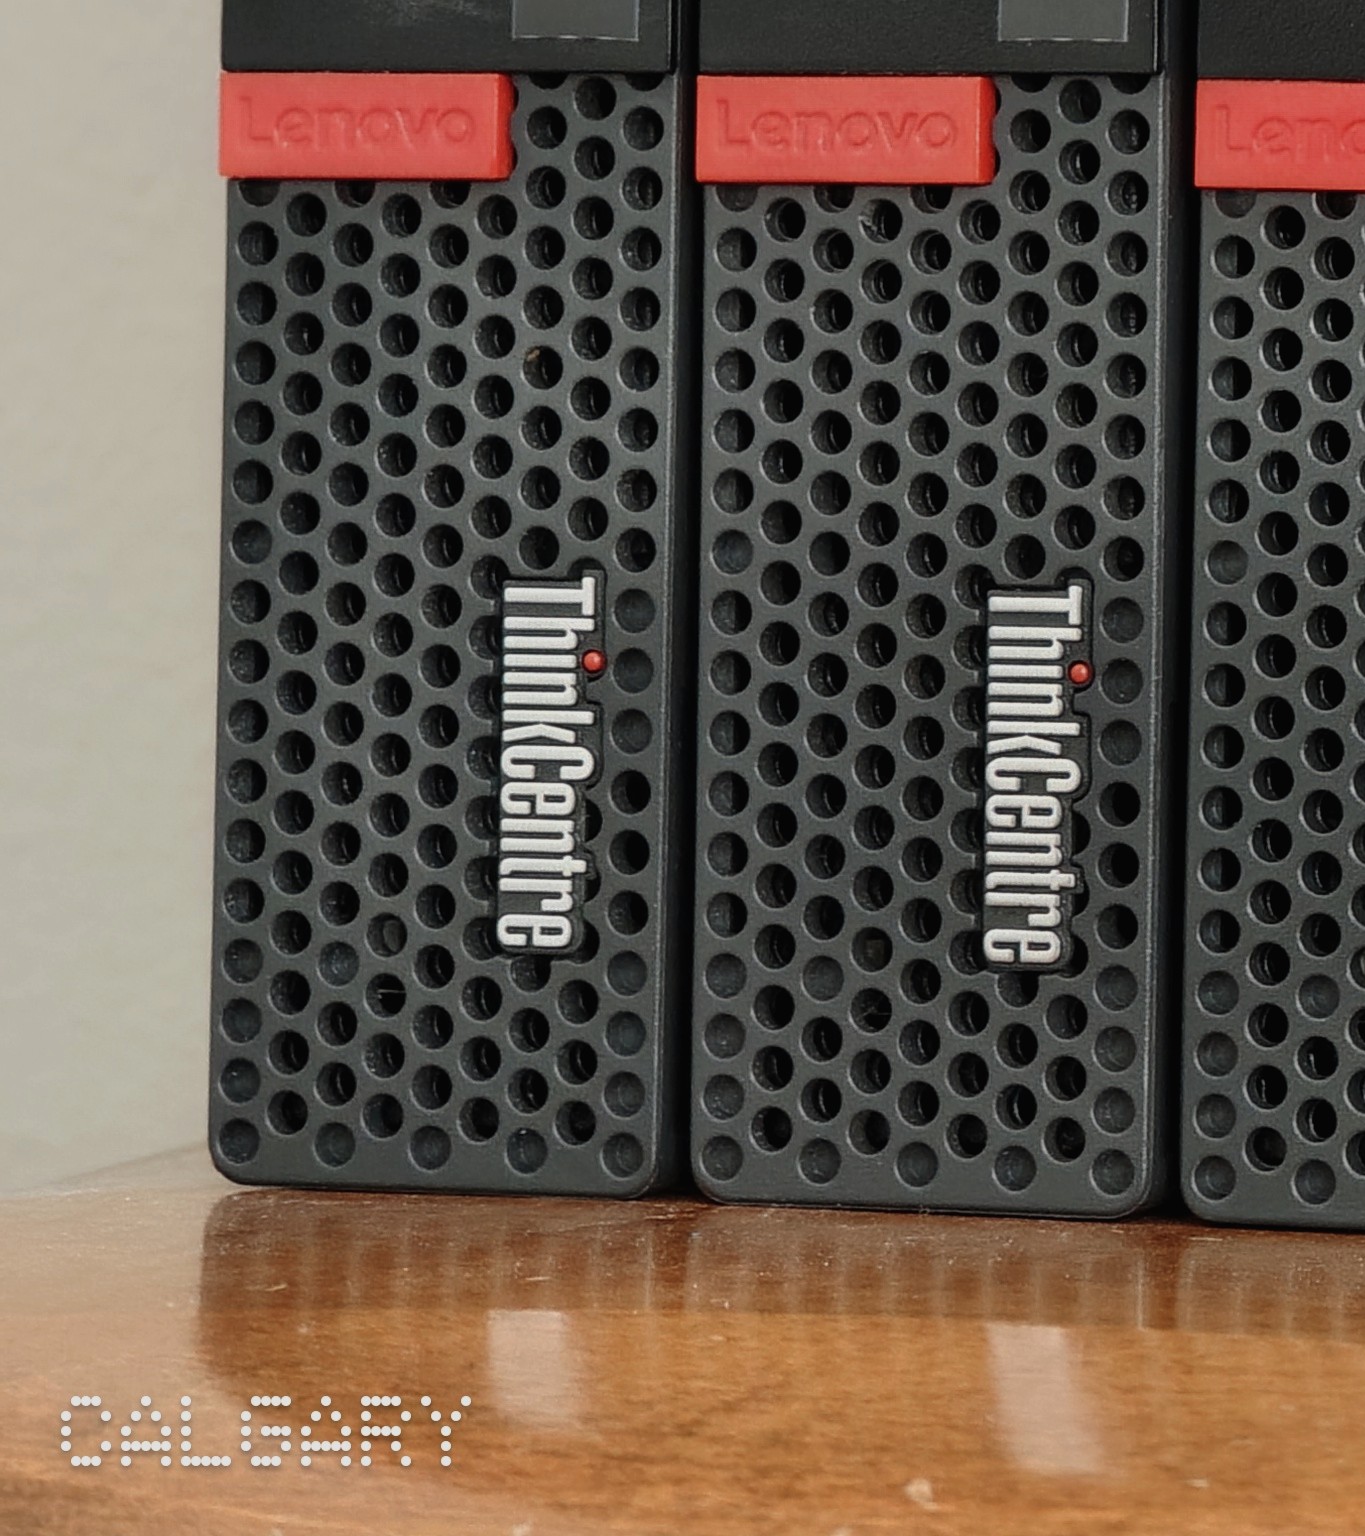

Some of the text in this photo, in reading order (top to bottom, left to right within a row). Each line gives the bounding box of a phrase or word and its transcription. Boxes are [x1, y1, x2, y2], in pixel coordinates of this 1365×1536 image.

[237, 97, 478, 149] Lenovo
[715, 100, 960, 156] Lenovo
[497, 576, 606, 948] ThinkCentre
[982, 585, 1093, 964] ThinkCentre
